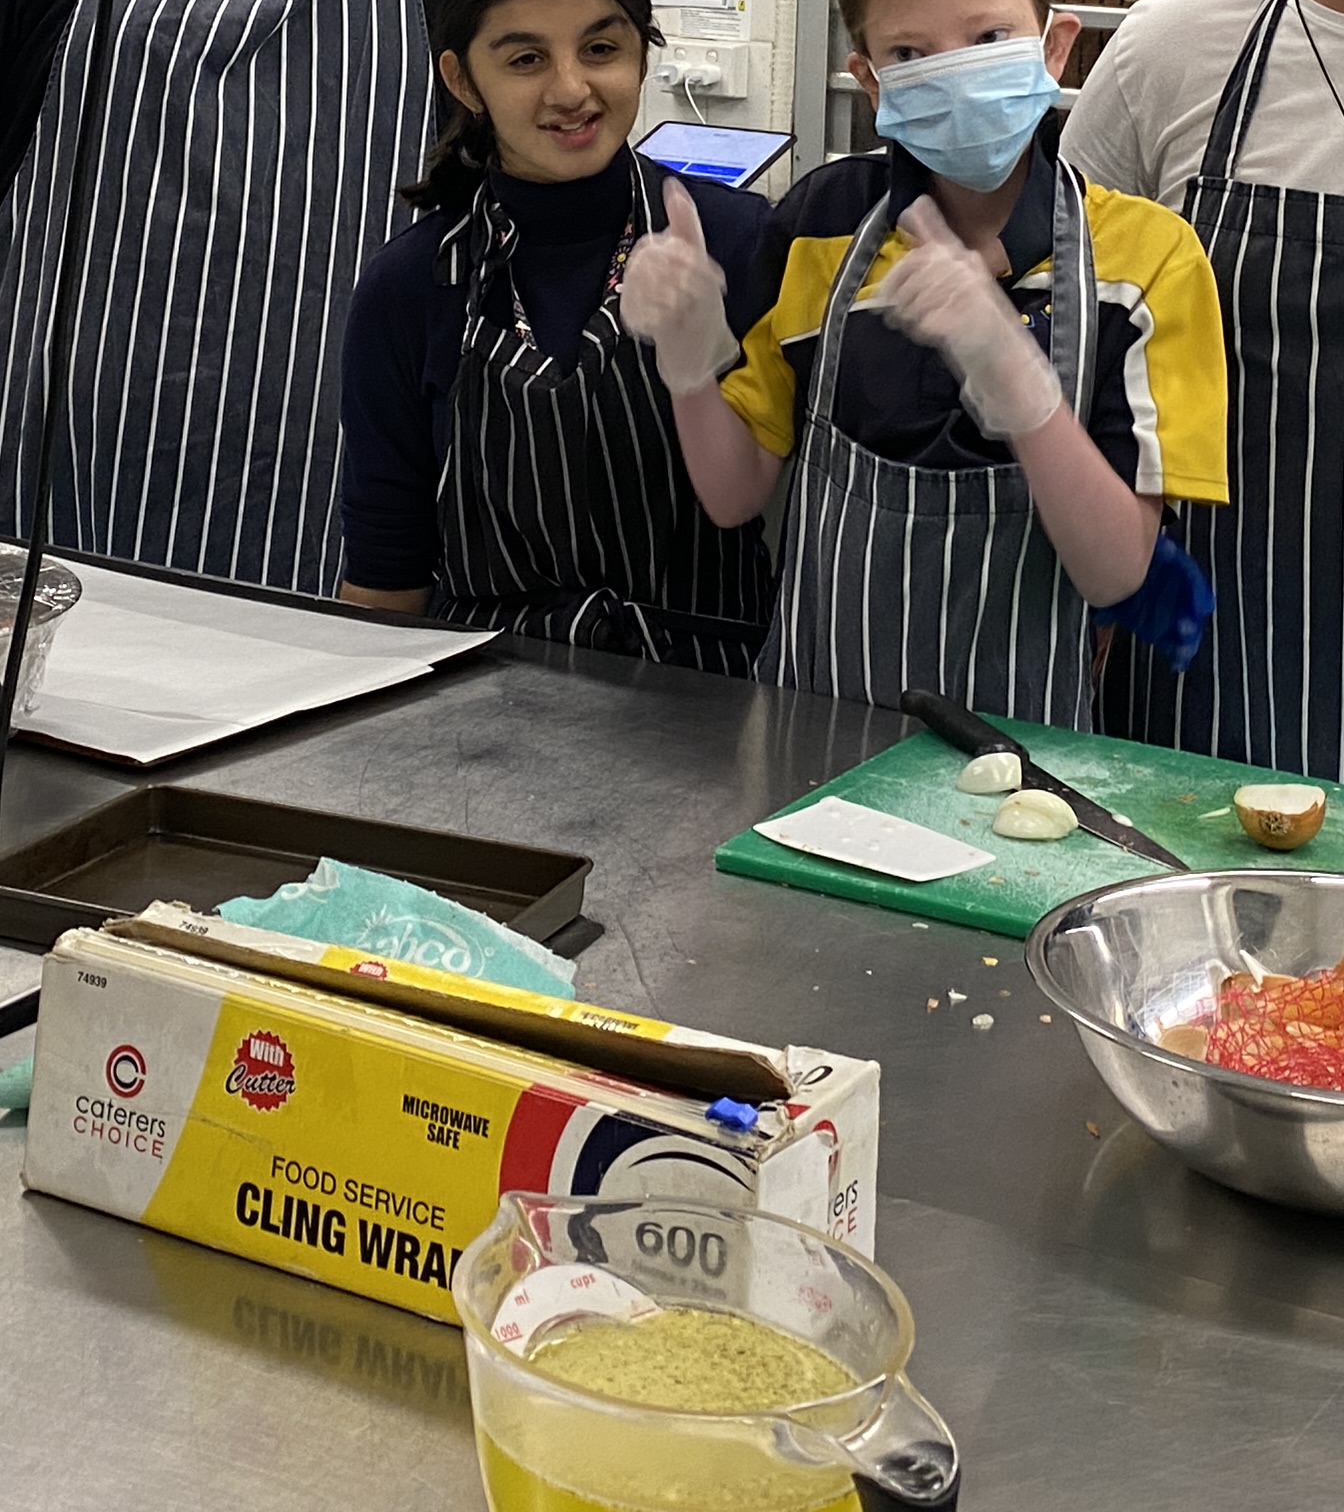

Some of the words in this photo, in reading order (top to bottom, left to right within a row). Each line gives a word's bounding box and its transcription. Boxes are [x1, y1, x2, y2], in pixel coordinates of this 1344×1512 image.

[77, 969, 108, 990] 74939
[249, 1037, 286, 1066] With
[224, 1063, 297, 1096] Cutter
[75, 1095, 167, 1138] caterers
[402, 1093, 490, 1138] MICROWAVE
[73, 1116, 165, 1160] CHOICE
[426, 1123, 461, 1150] SAFE
[271, 1156, 337, 1195] FOOD
[343, 1180, 447, 1231] SERVICE
[236, 1182, 347, 1256] CLING
[635, 1220, 728, 1275] 600
[570, 1272, 596, 1289] cups
[514, 1289, 531, 1306] ml
[494, 1322, 520, 1341] 1000
